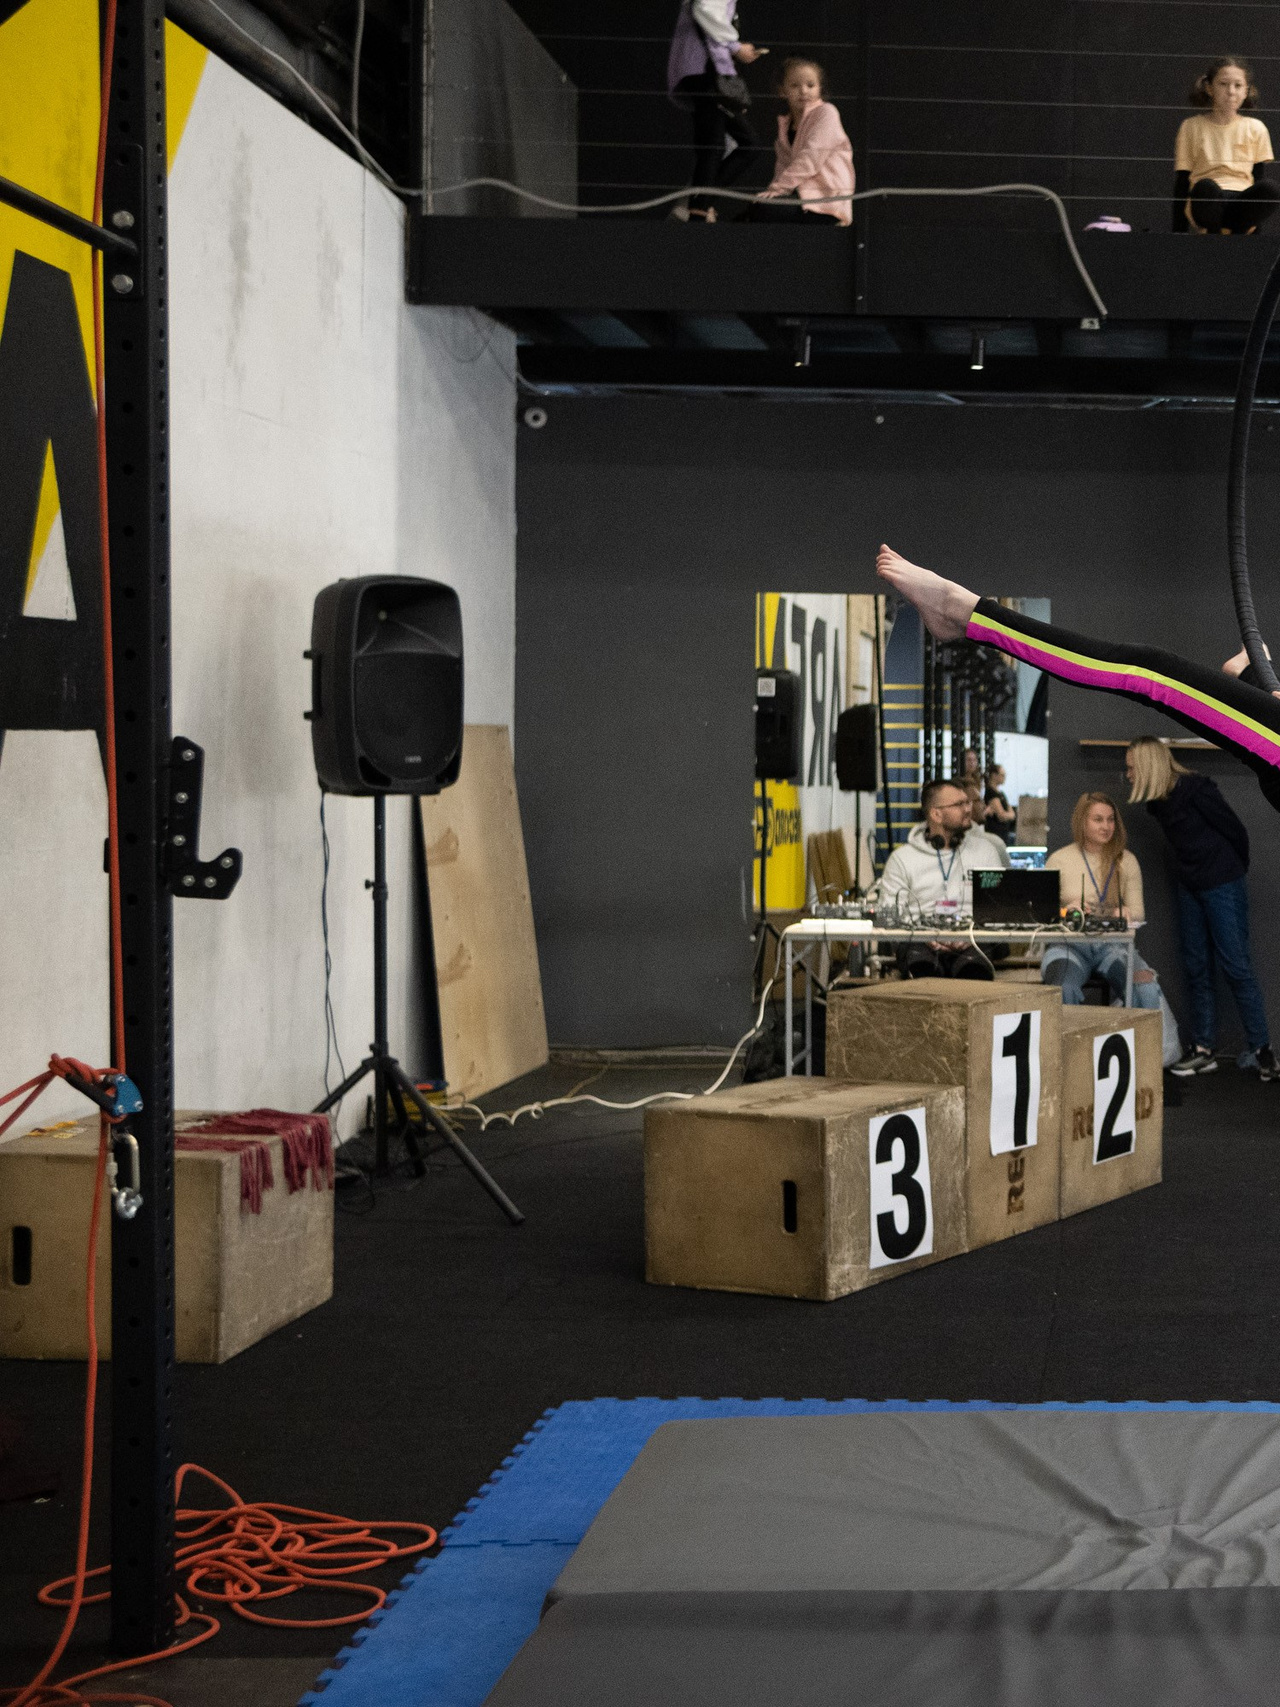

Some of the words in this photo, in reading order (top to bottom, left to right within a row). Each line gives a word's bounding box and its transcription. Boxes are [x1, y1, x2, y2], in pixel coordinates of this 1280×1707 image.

[1002, 1013, 1031, 1147] 1
[1096, 1033, 1131, 1162] 2
[876, 1114, 927, 1259] 3
